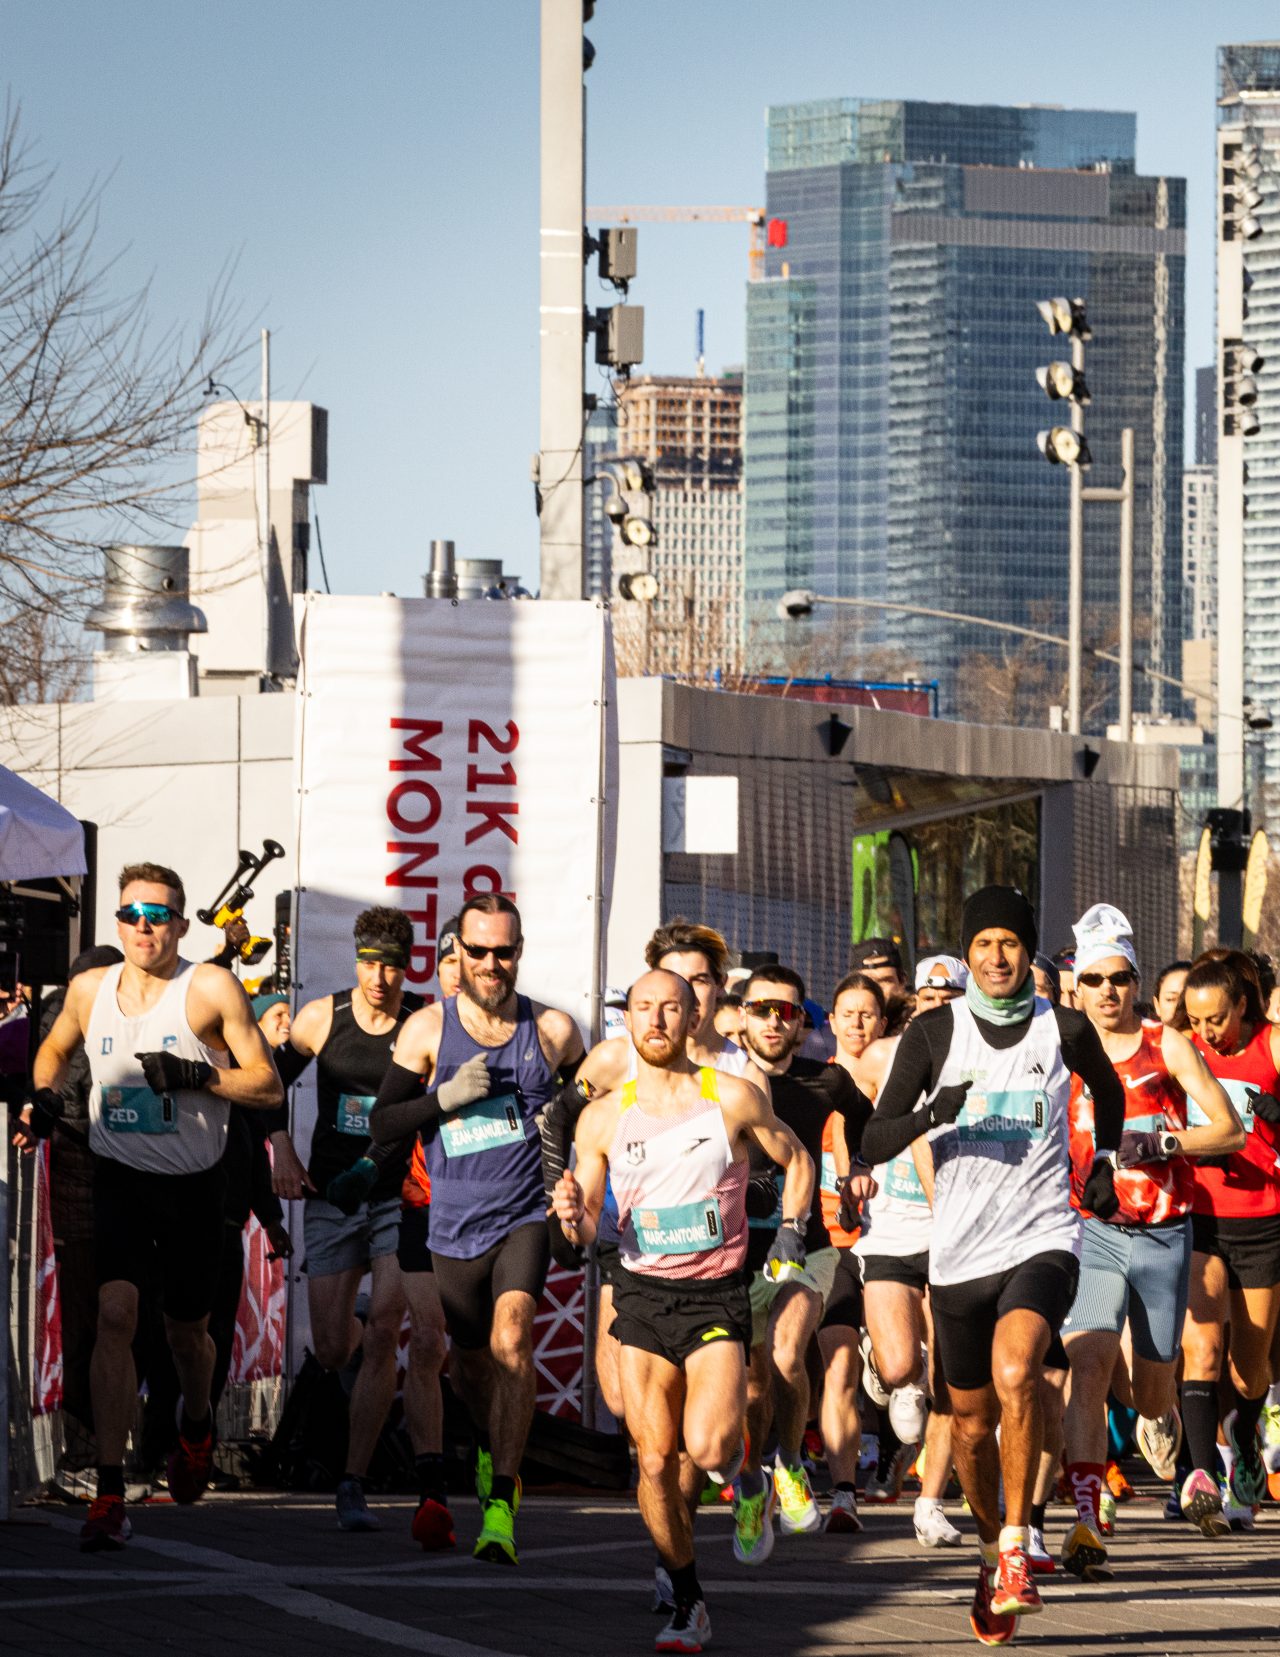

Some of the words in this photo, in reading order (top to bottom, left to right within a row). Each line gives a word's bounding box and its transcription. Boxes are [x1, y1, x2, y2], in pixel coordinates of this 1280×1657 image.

[465, 719, 519, 846] 21K
[385, 717, 443, 1003] MONTR
[108, 1108, 139, 1123] ZED
[967, 1114, 1032, 1132] BAGHDAD
[451, 1119, 509, 1147] JEAN-SAMUEL
[642, 1223, 708, 1247] MARC-ANTOINE
